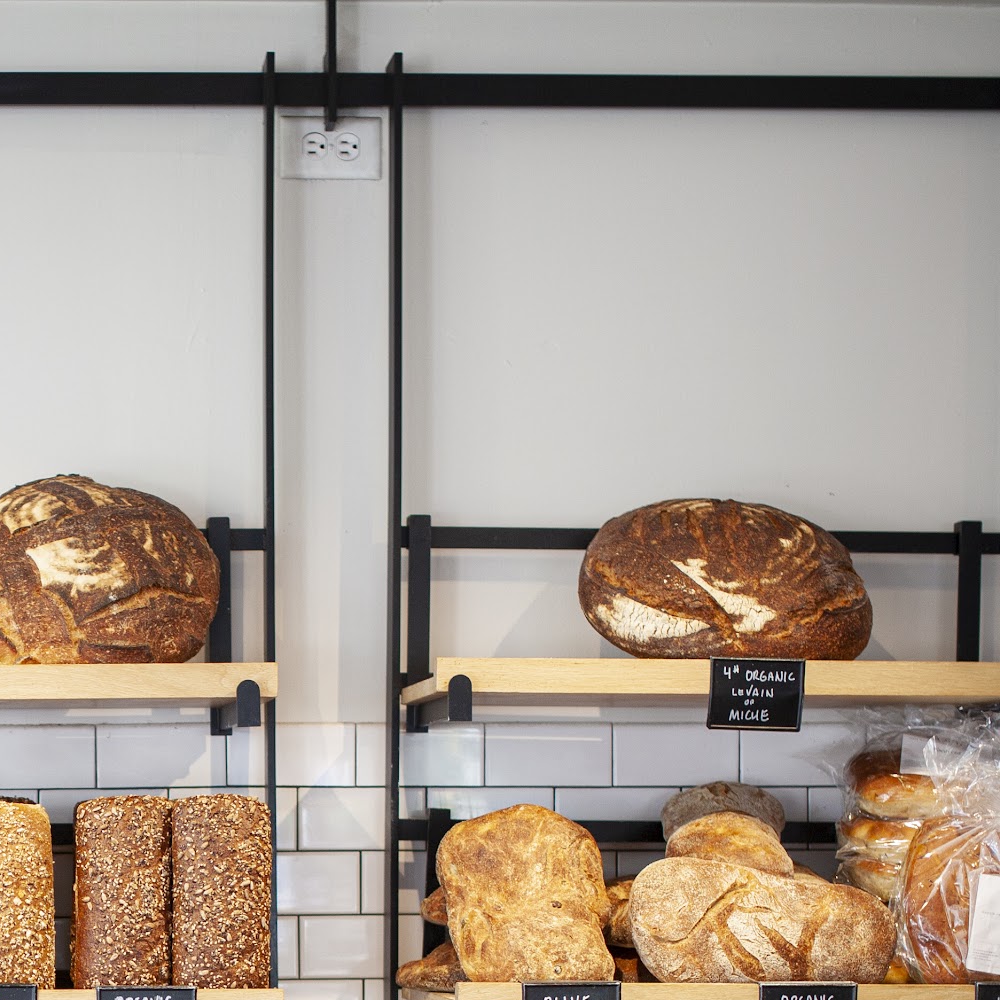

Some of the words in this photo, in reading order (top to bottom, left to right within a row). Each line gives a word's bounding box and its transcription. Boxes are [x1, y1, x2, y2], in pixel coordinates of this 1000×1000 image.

[745, 669, 796, 682] ORGANIC
[731, 684, 774, 698] LEVAIN
[728, 709, 770, 722] MICHE
